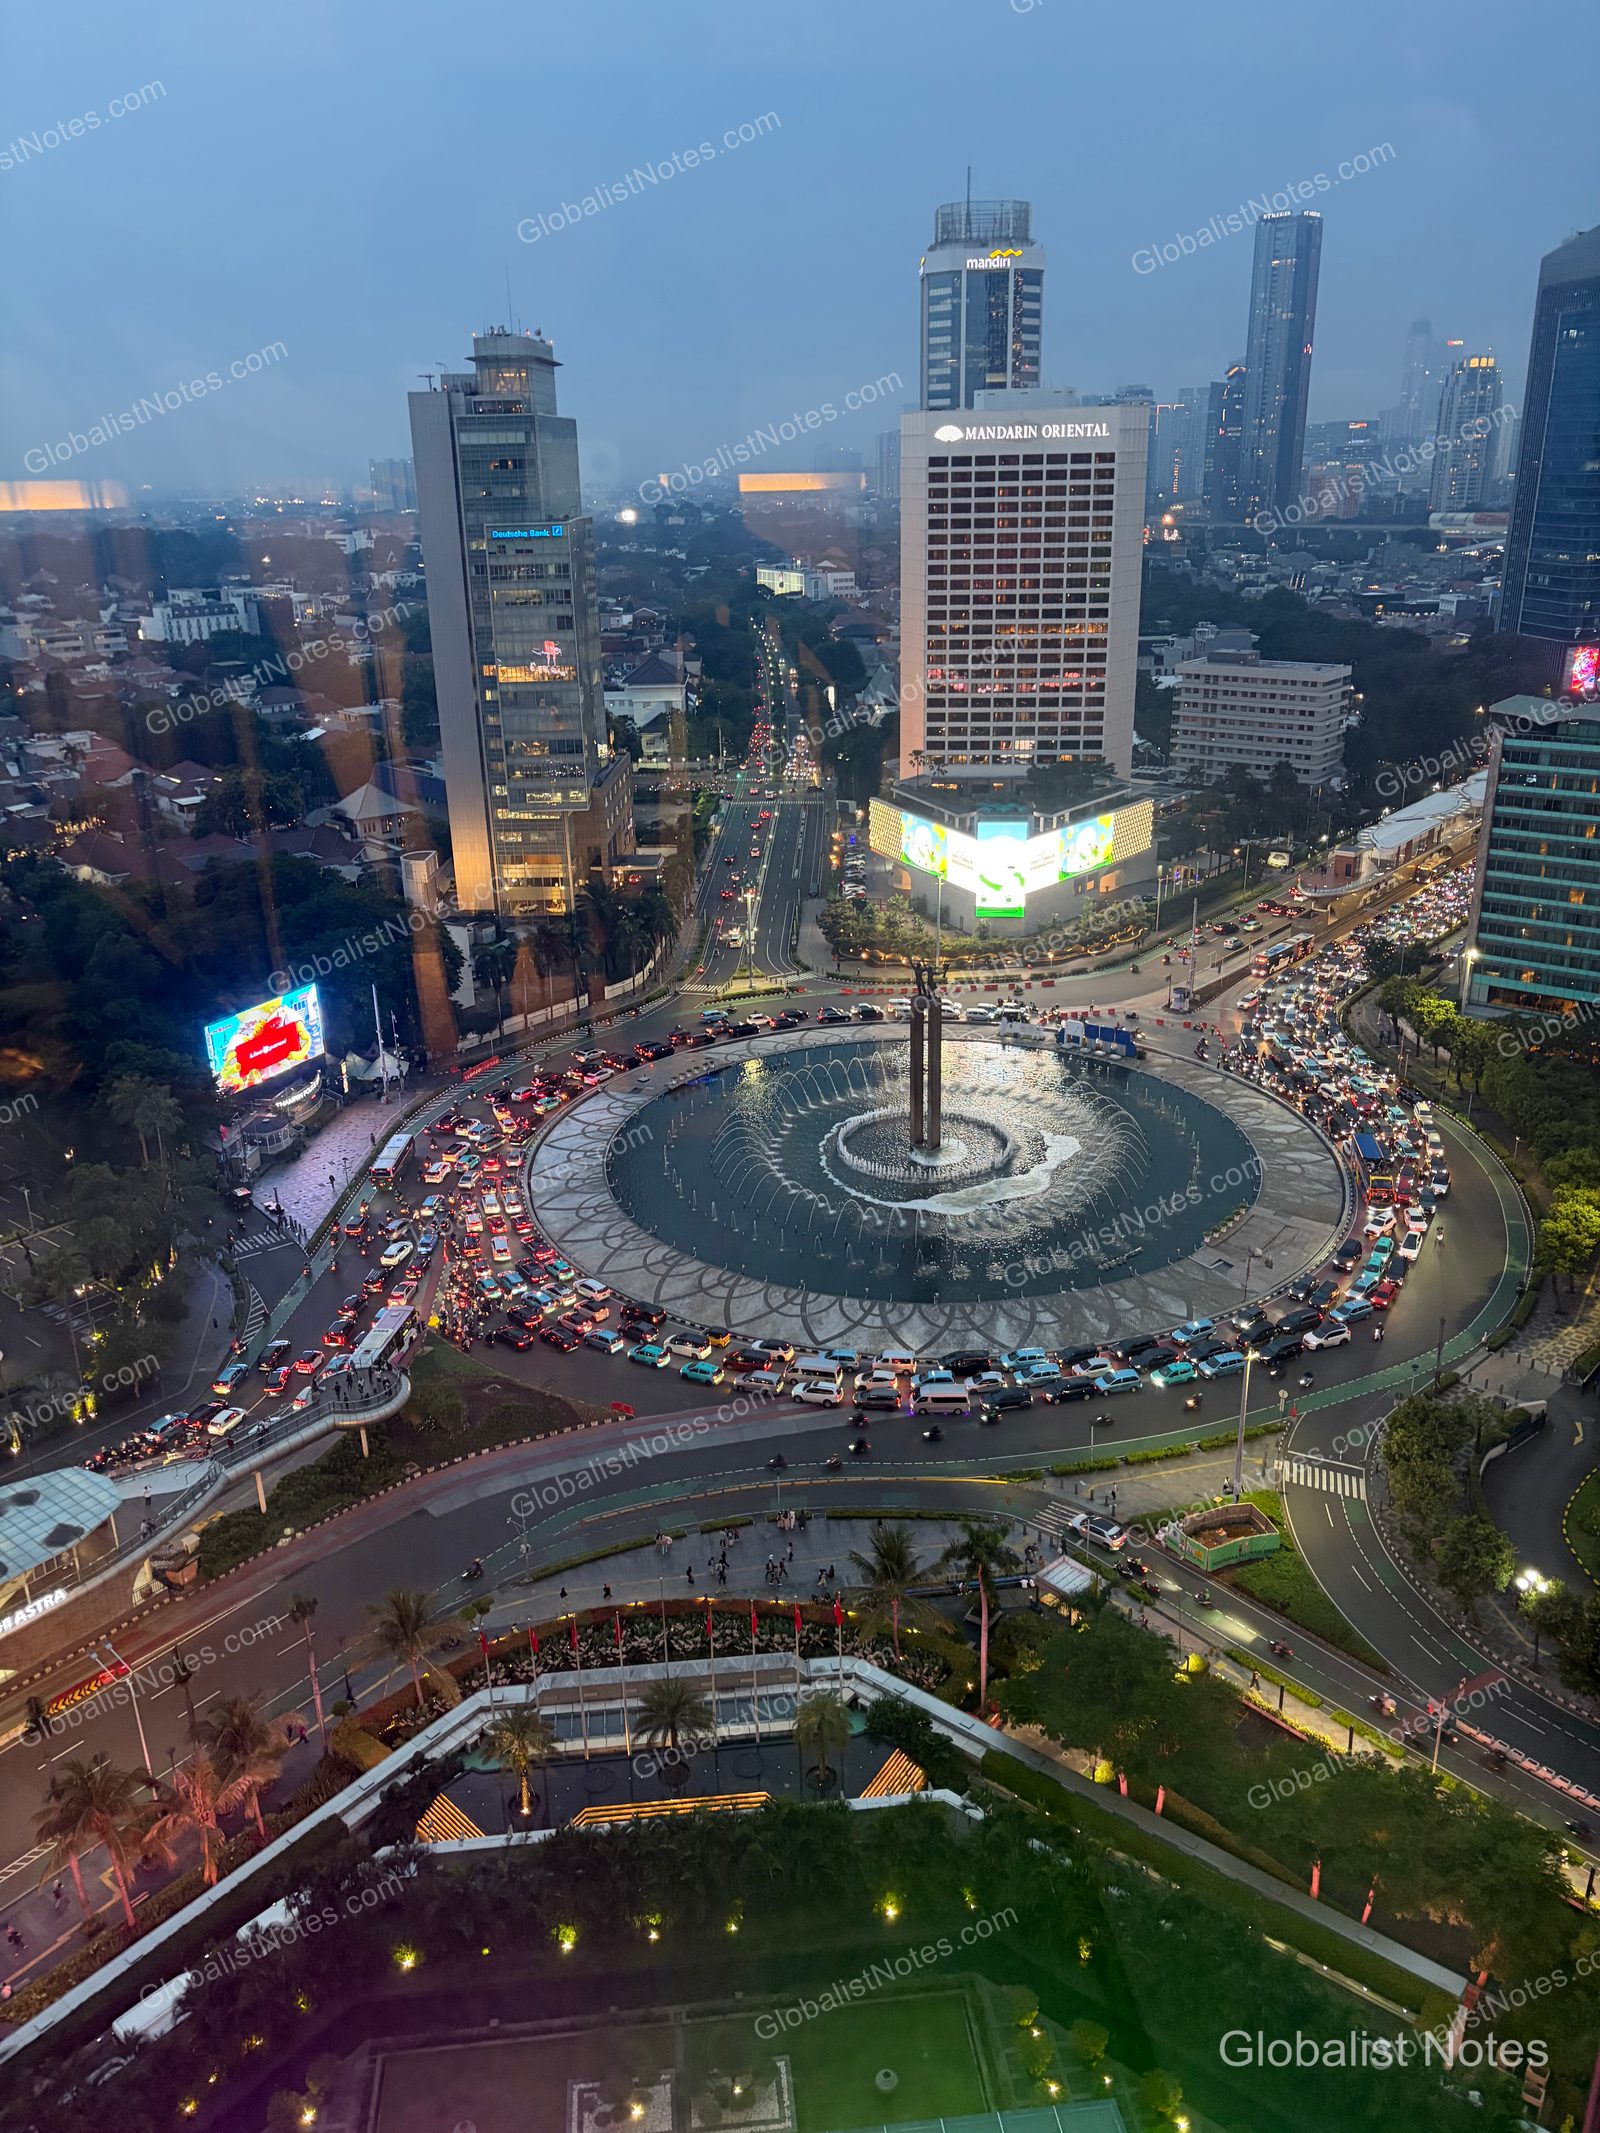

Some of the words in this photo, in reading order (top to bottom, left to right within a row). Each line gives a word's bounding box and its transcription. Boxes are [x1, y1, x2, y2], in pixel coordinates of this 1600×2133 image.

[966, 255, 1011, 270] mandiri
[965, 425, 1038, 440] MANDARIN
[1041, 422, 1110, 439] ORIENTAL
[492, 530, 528, 539] Deutsche
[529, 529, 550, 538] Bank
[15, 1588, 68, 1626] ASTRA
